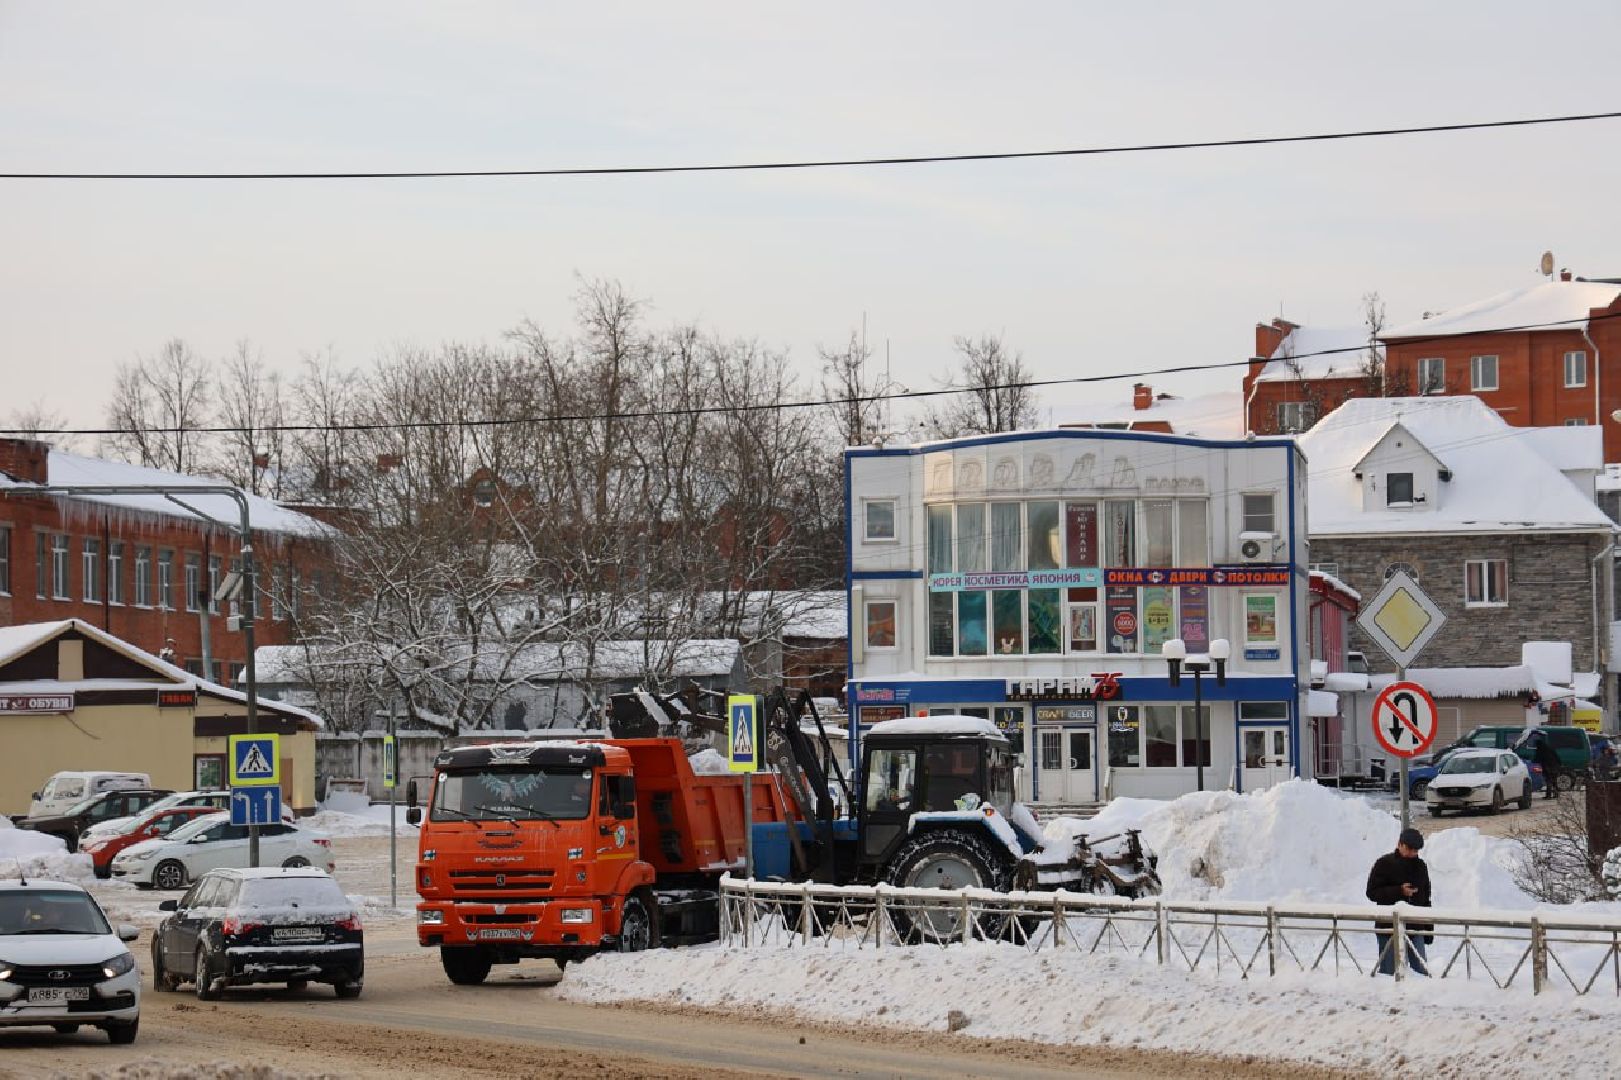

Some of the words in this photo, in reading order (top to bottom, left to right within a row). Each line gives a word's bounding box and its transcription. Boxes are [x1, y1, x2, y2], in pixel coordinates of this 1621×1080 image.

[933, 577, 962, 588] КОРЕЯ
[965, 575, 1030, 586] КОСМЕТИКА
[1032, 573, 1081, 584] ЯПОНИЯ
[1108, 571, 1143, 583] ОКНА
[1169, 572, 1207, 583] ДВЕРИ
[1227, 572, 1288, 583] ПОТОЛКИ
[29, 697, 69, 708] ОБУВИ
[1068, 709, 1094, 719] BEER
